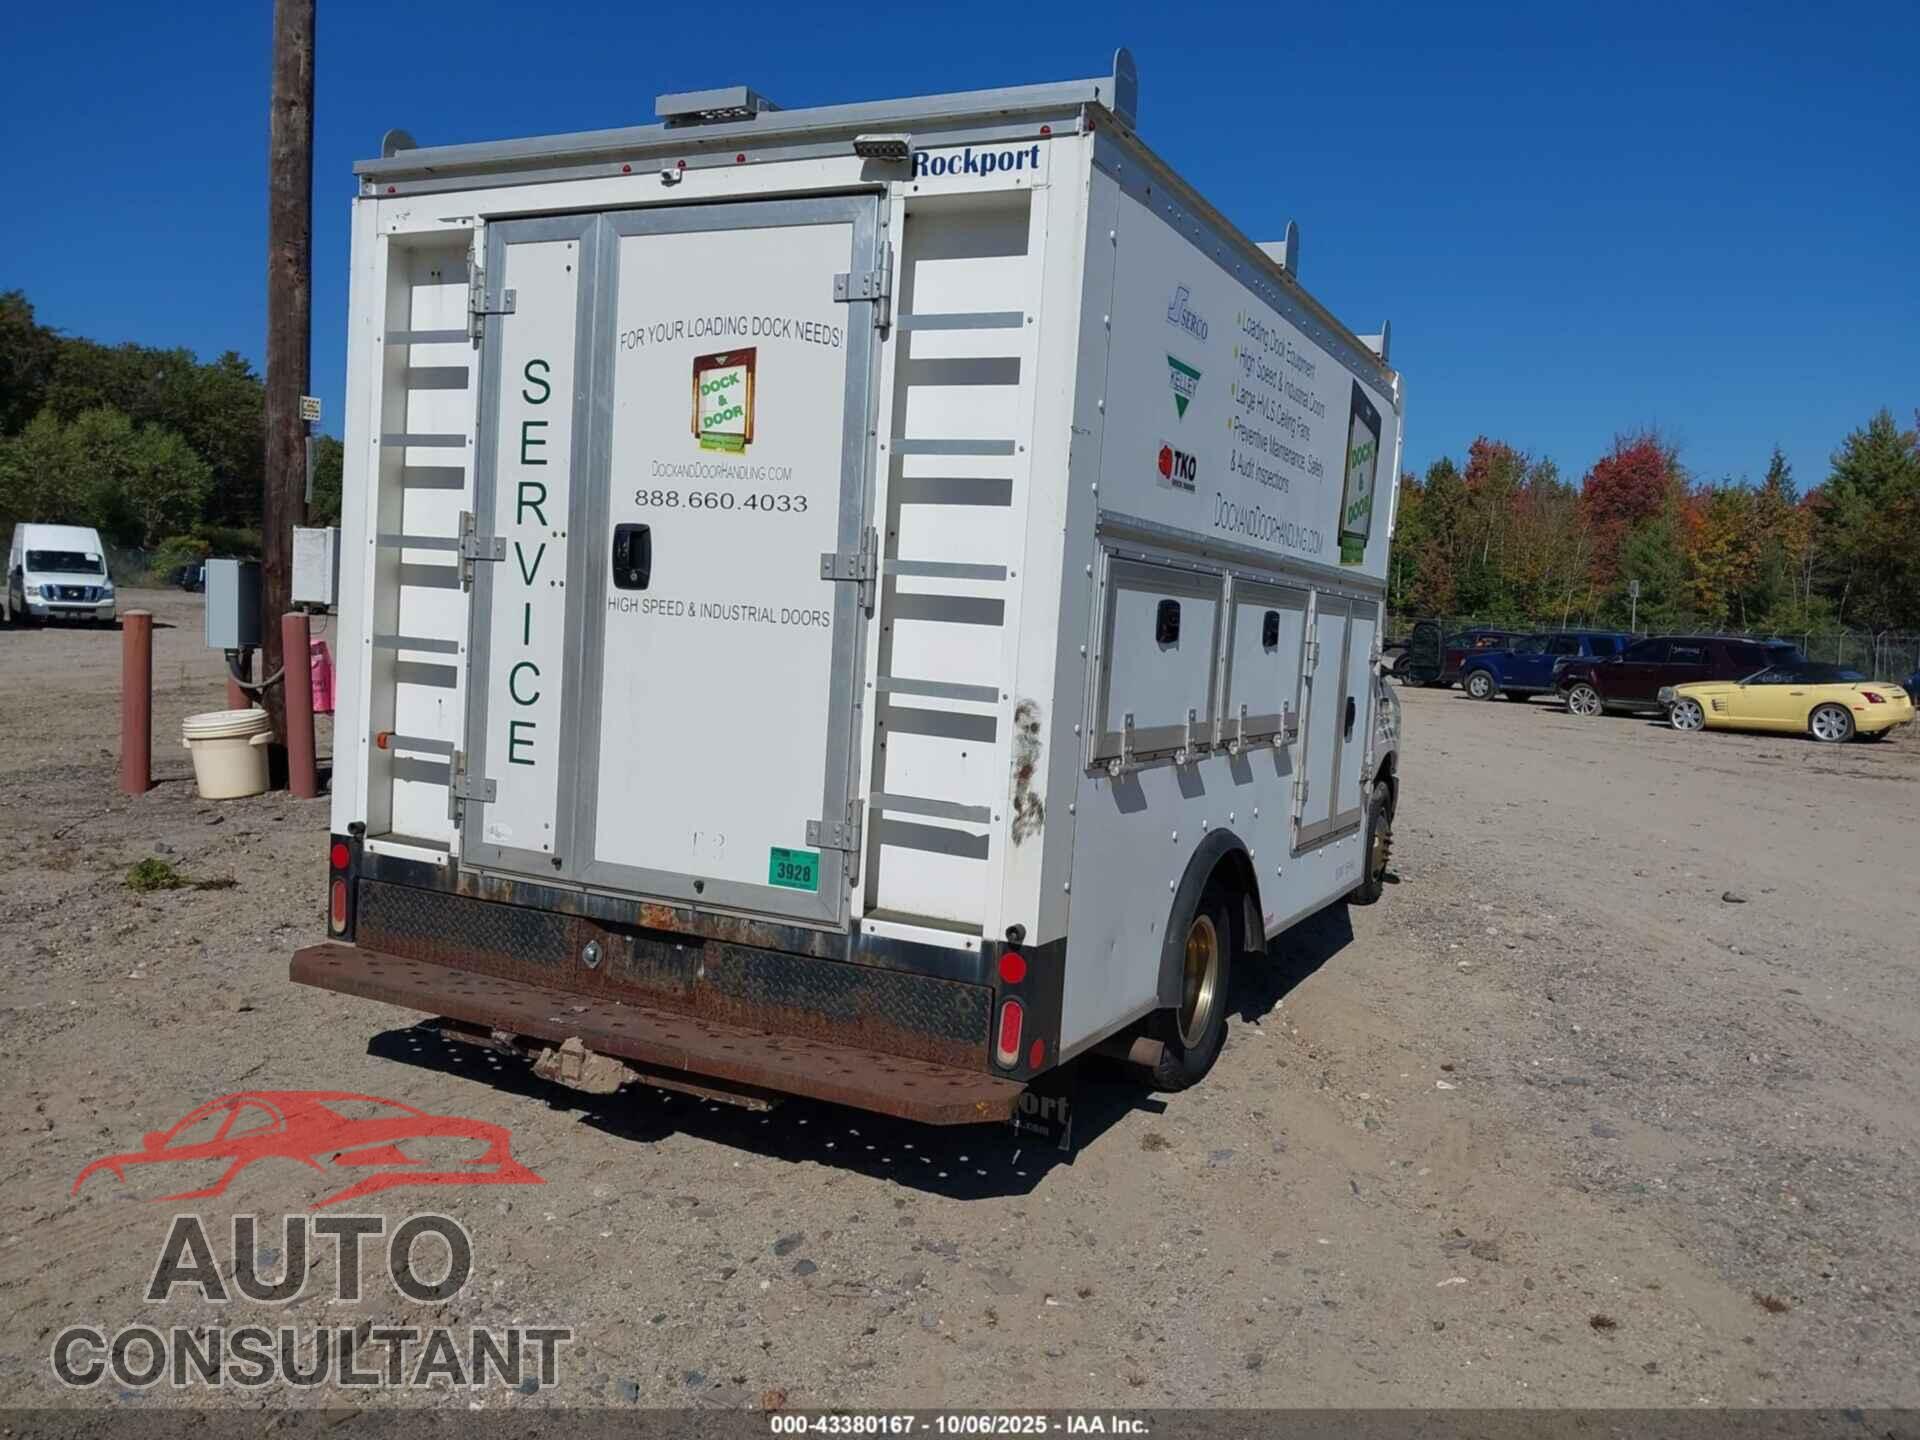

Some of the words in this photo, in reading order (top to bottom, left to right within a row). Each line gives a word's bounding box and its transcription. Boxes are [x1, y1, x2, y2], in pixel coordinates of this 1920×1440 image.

[912, 144, 1040, 177] Rockport
[620, 328, 645, 352] FOR
[649, 320, 684, 344] YOUR
[687, 316, 748, 339] LOADING
[752, 316, 791, 339] DOCK
[795, 320, 844, 349] NEEDS!
[1243, 310, 1268, 352] Loading
[1240, 344, 1256, 378] High
[701, 372, 740, 396] DOCK
[718, 394, 728, 406] &
[1236, 380, 1256, 414] Large
[704, 405, 744, 429] DOOR
[1174, 450, 1197, 482] TKO
[634, 489, 809, 513] 888.660.4033
[508, 359, 552, 766] SERVICE
[608, 596, 638, 614] HIGH
[641, 598, 684, 617] SPEED
[687, 601, 696, 617] &
[700, 602, 777, 624] INDUSTRIAL
[780, 608, 830, 628] DOORS
[777, 862, 811, 882] 3928
